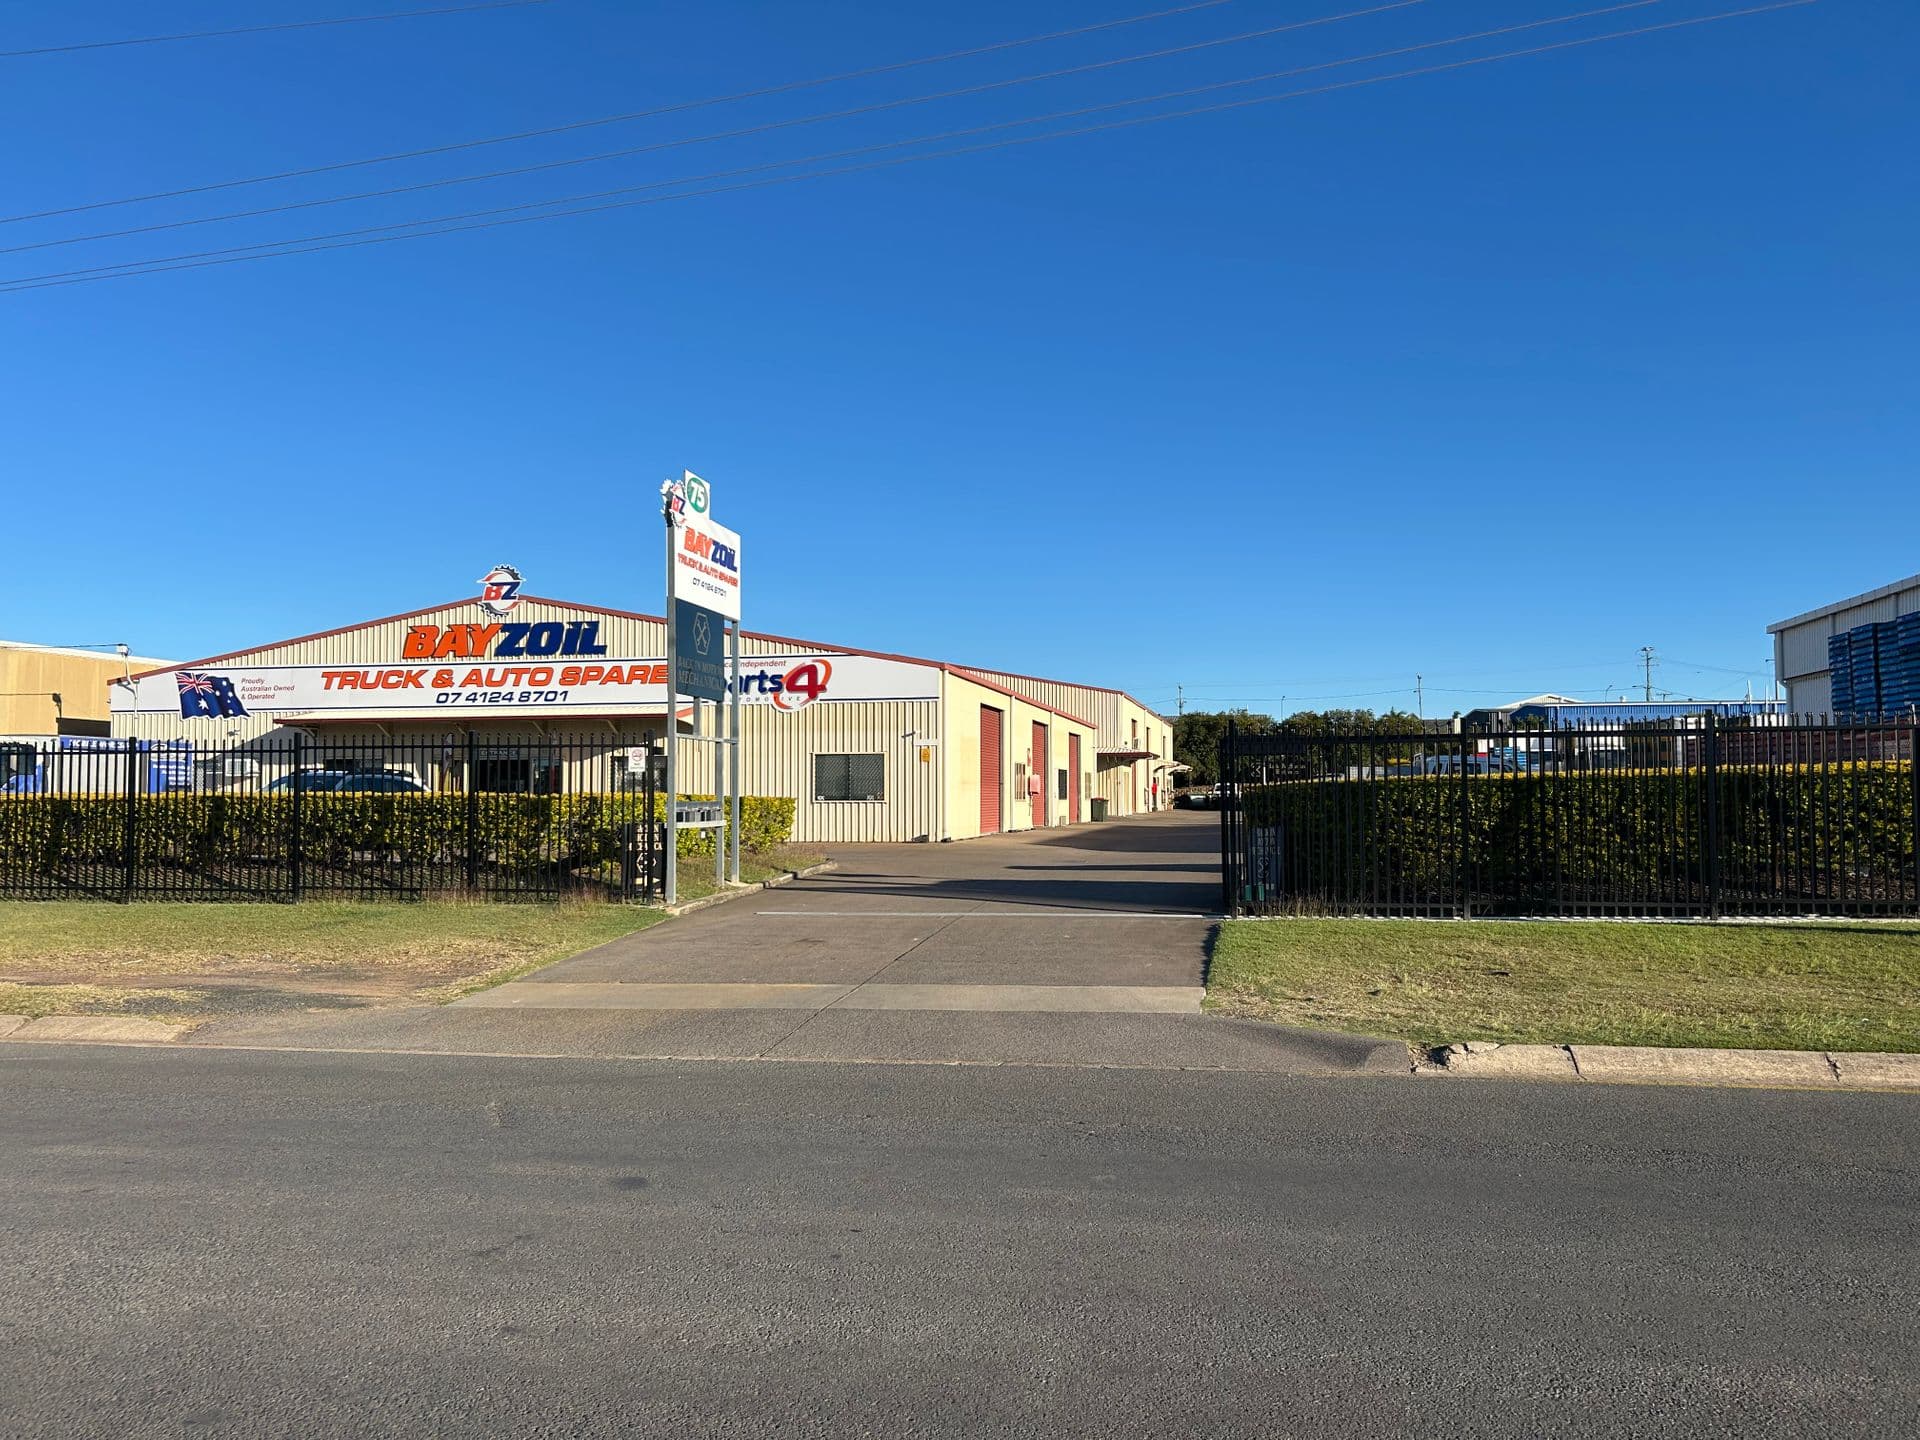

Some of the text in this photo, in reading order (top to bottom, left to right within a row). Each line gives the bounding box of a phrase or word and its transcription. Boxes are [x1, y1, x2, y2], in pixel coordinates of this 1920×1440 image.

[690, 481, 705, 508] 75
[684, 526, 738, 573] BAYZOIL
[483, 581, 521, 601] BZ
[402, 620, 607, 659] BAYZOIL
[321, 665, 669, 690] TRUCK & AUTO SPARE
[436, 690, 569, 704] 07 4124 8701
